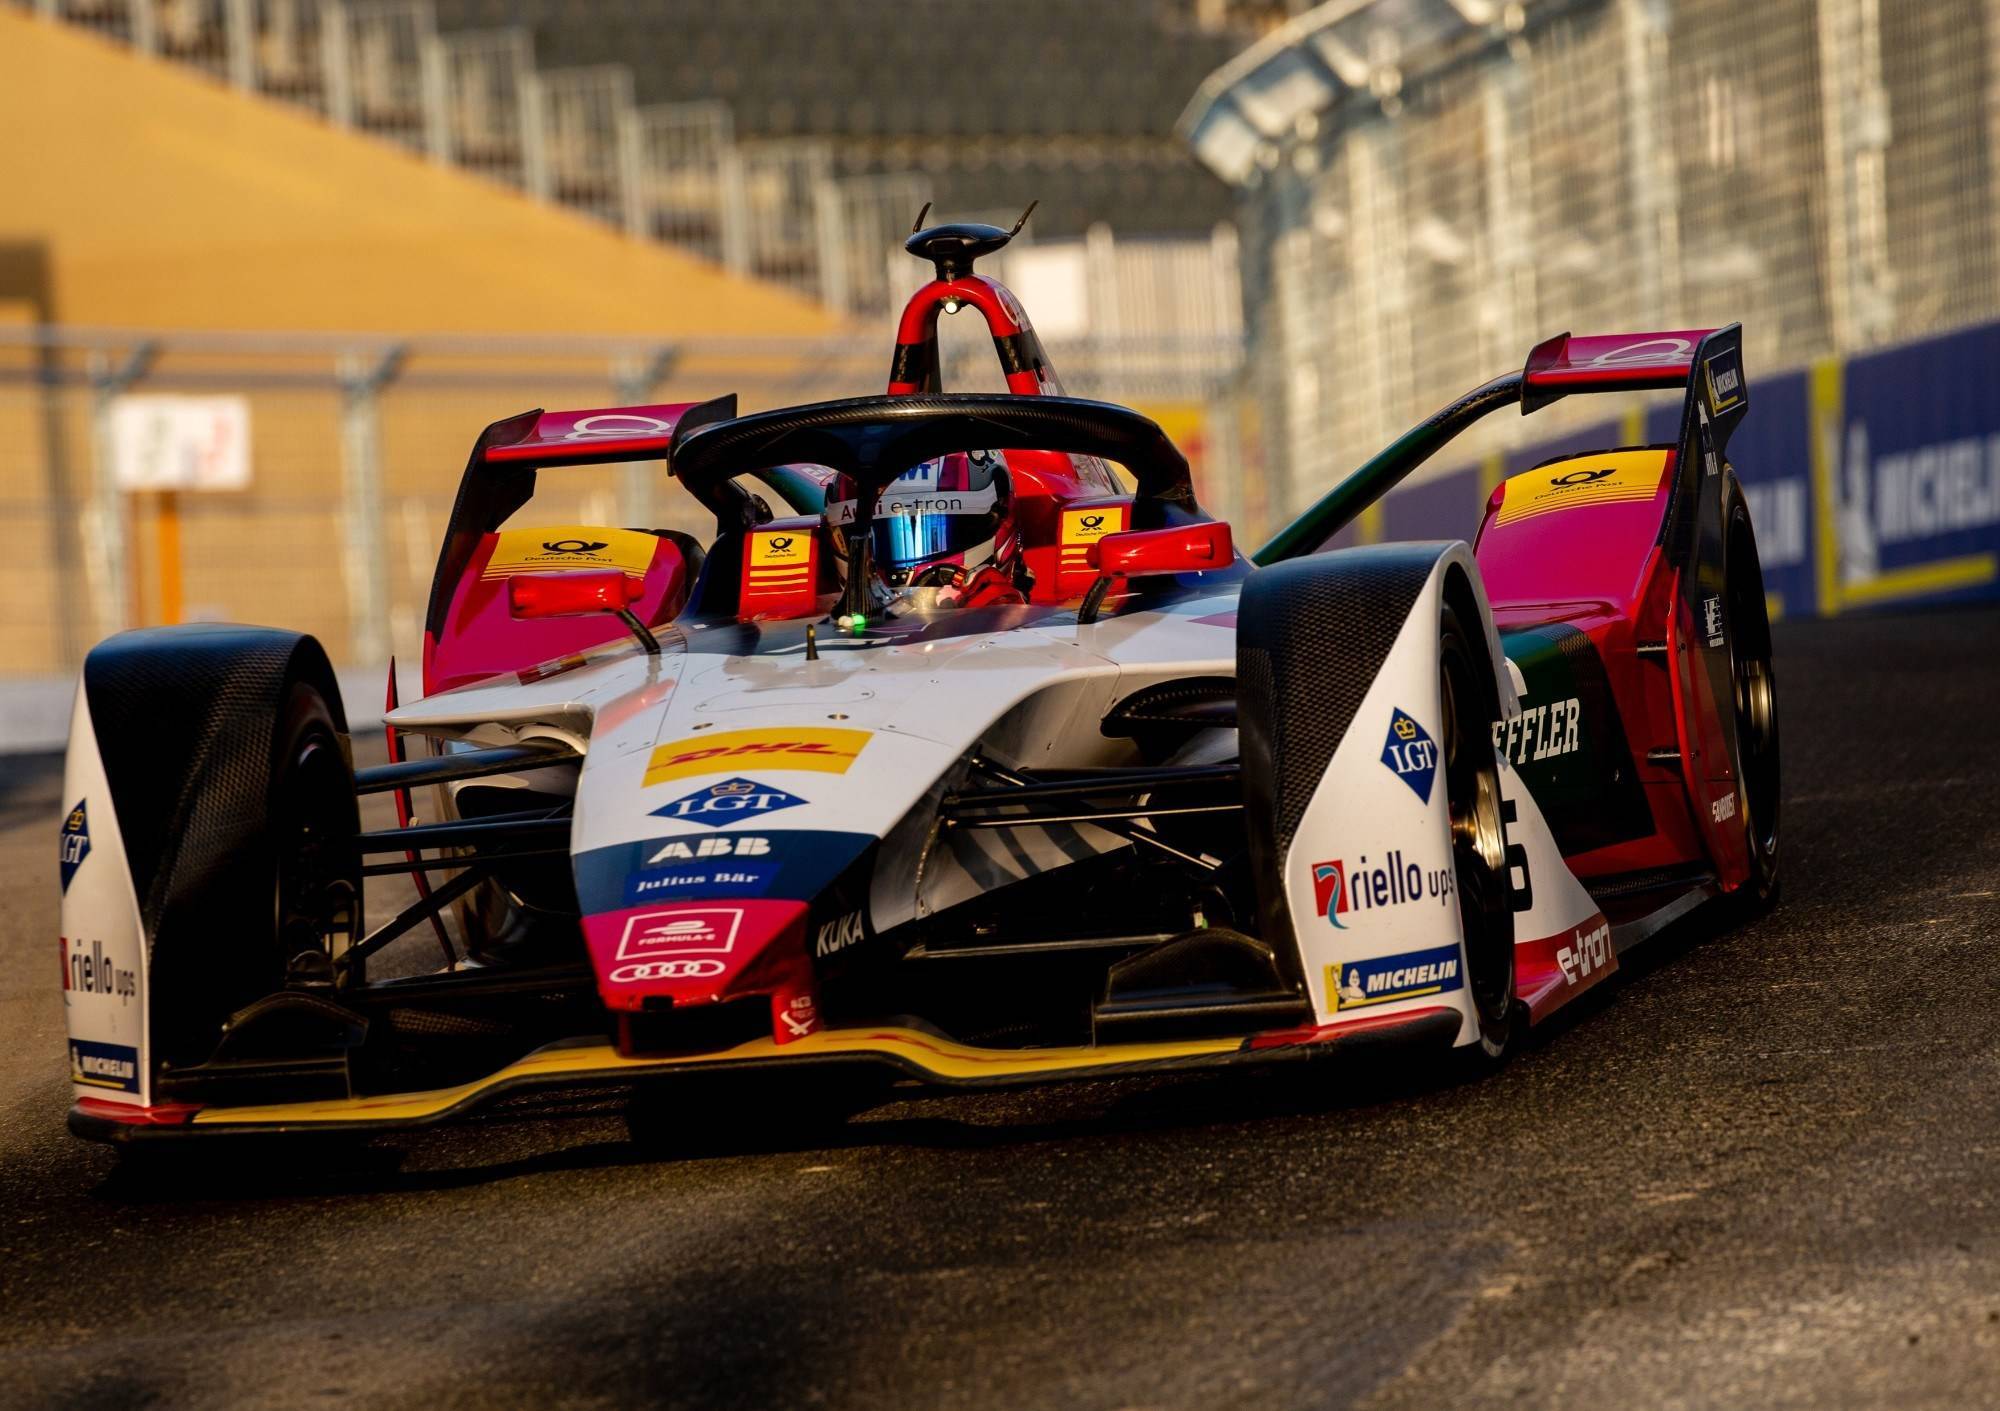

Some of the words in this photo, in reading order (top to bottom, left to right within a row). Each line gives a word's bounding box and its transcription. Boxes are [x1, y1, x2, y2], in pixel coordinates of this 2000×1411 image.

[841, 500, 883, 521] Ai
[890, 498, 963, 513] e-tron
[1491, 697, 1580, 765] EFFLER
[664, 742, 840, 767] DHL
[1388, 739, 1434, 774] LGT
[672, 793, 787, 817] LGT
[647, 837, 772, 864] ABB
[636, 875, 707, 893] Julius
[713, 872, 760, 884] Bär
[1350, 849, 1423, 912] riello
[1427, 866, 1454, 907] ups
[816, 909, 865, 958] KUKA
[72, 938, 113, 994] riello
[1366, 958, 1458, 994] MICHELIN
